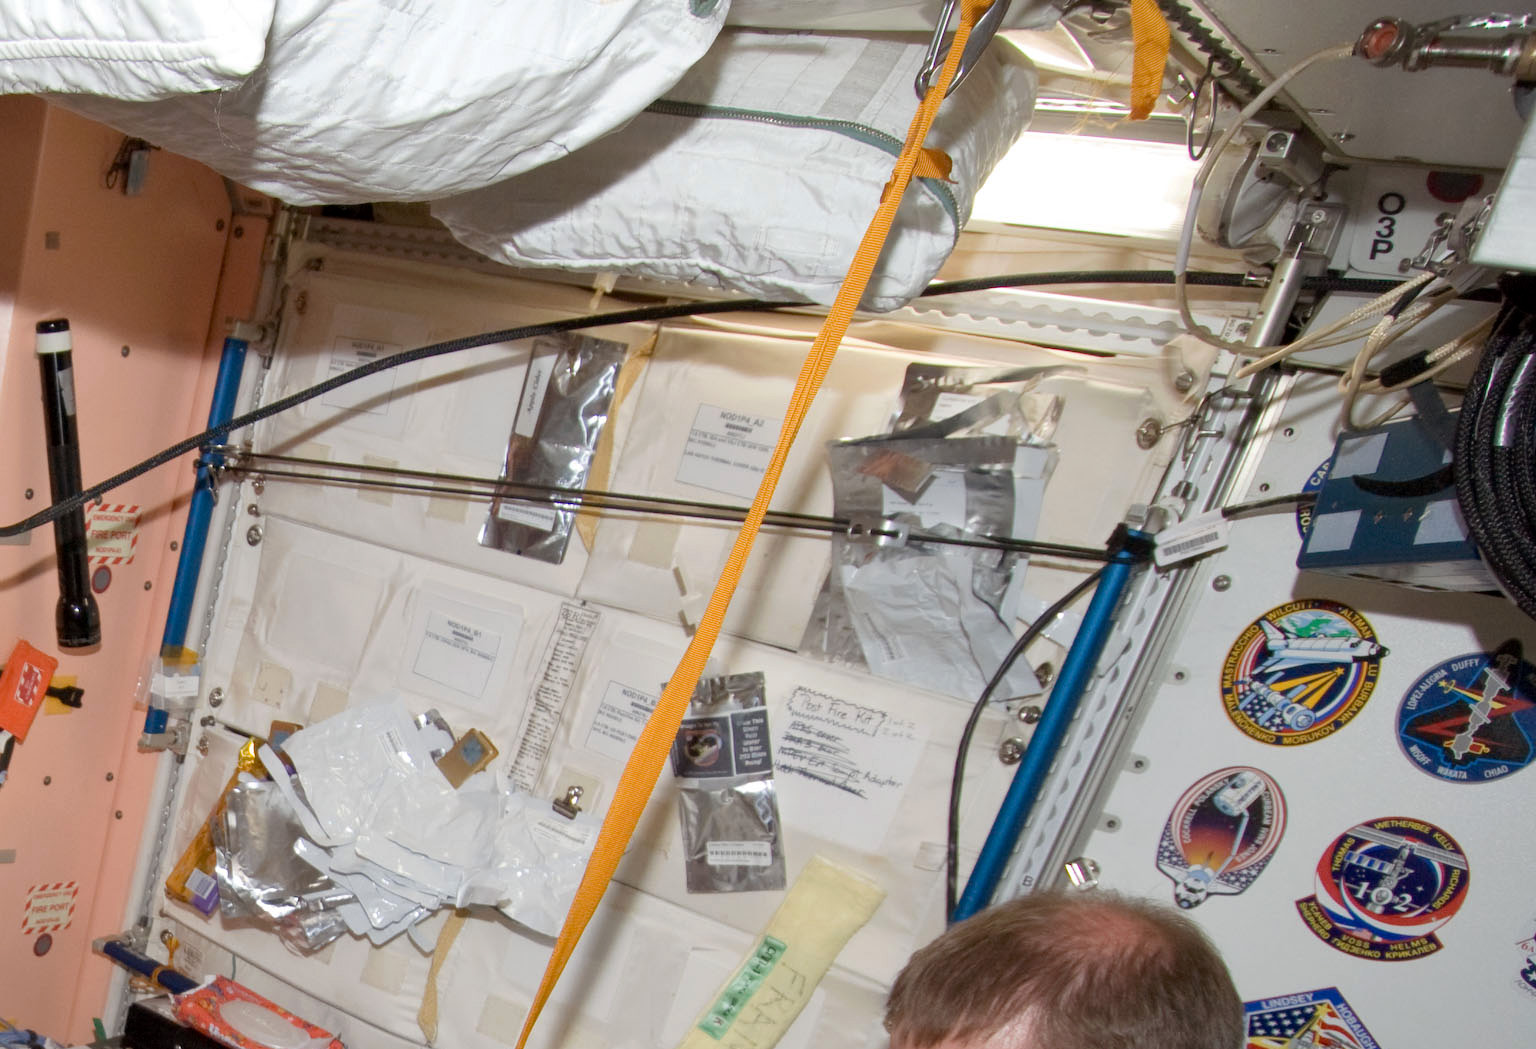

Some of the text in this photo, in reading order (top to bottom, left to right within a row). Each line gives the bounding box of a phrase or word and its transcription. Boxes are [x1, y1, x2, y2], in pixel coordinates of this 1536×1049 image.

[1339, 608, 1373, 639] ALTMAN
[1451, 658, 1480, 672] DUFFY
[1340, 680, 1373, 724] BURBANK
[828, 702, 848, 719] Fire
[856, 710, 873, 725] Kit
[1484, 765, 1509, 779] CHIAO
[1374, 820, 1432, 835] WETHERBEE
[1432, 832, 1455, 851] KELLY
[1332, 837, 1356, 872] THOMAS
[1432, 869, 1461, 909] RICHARDS
[1390, 938, 1428, 951] HELMS
[1260, 993, 1314, 1009] LINDSEY
